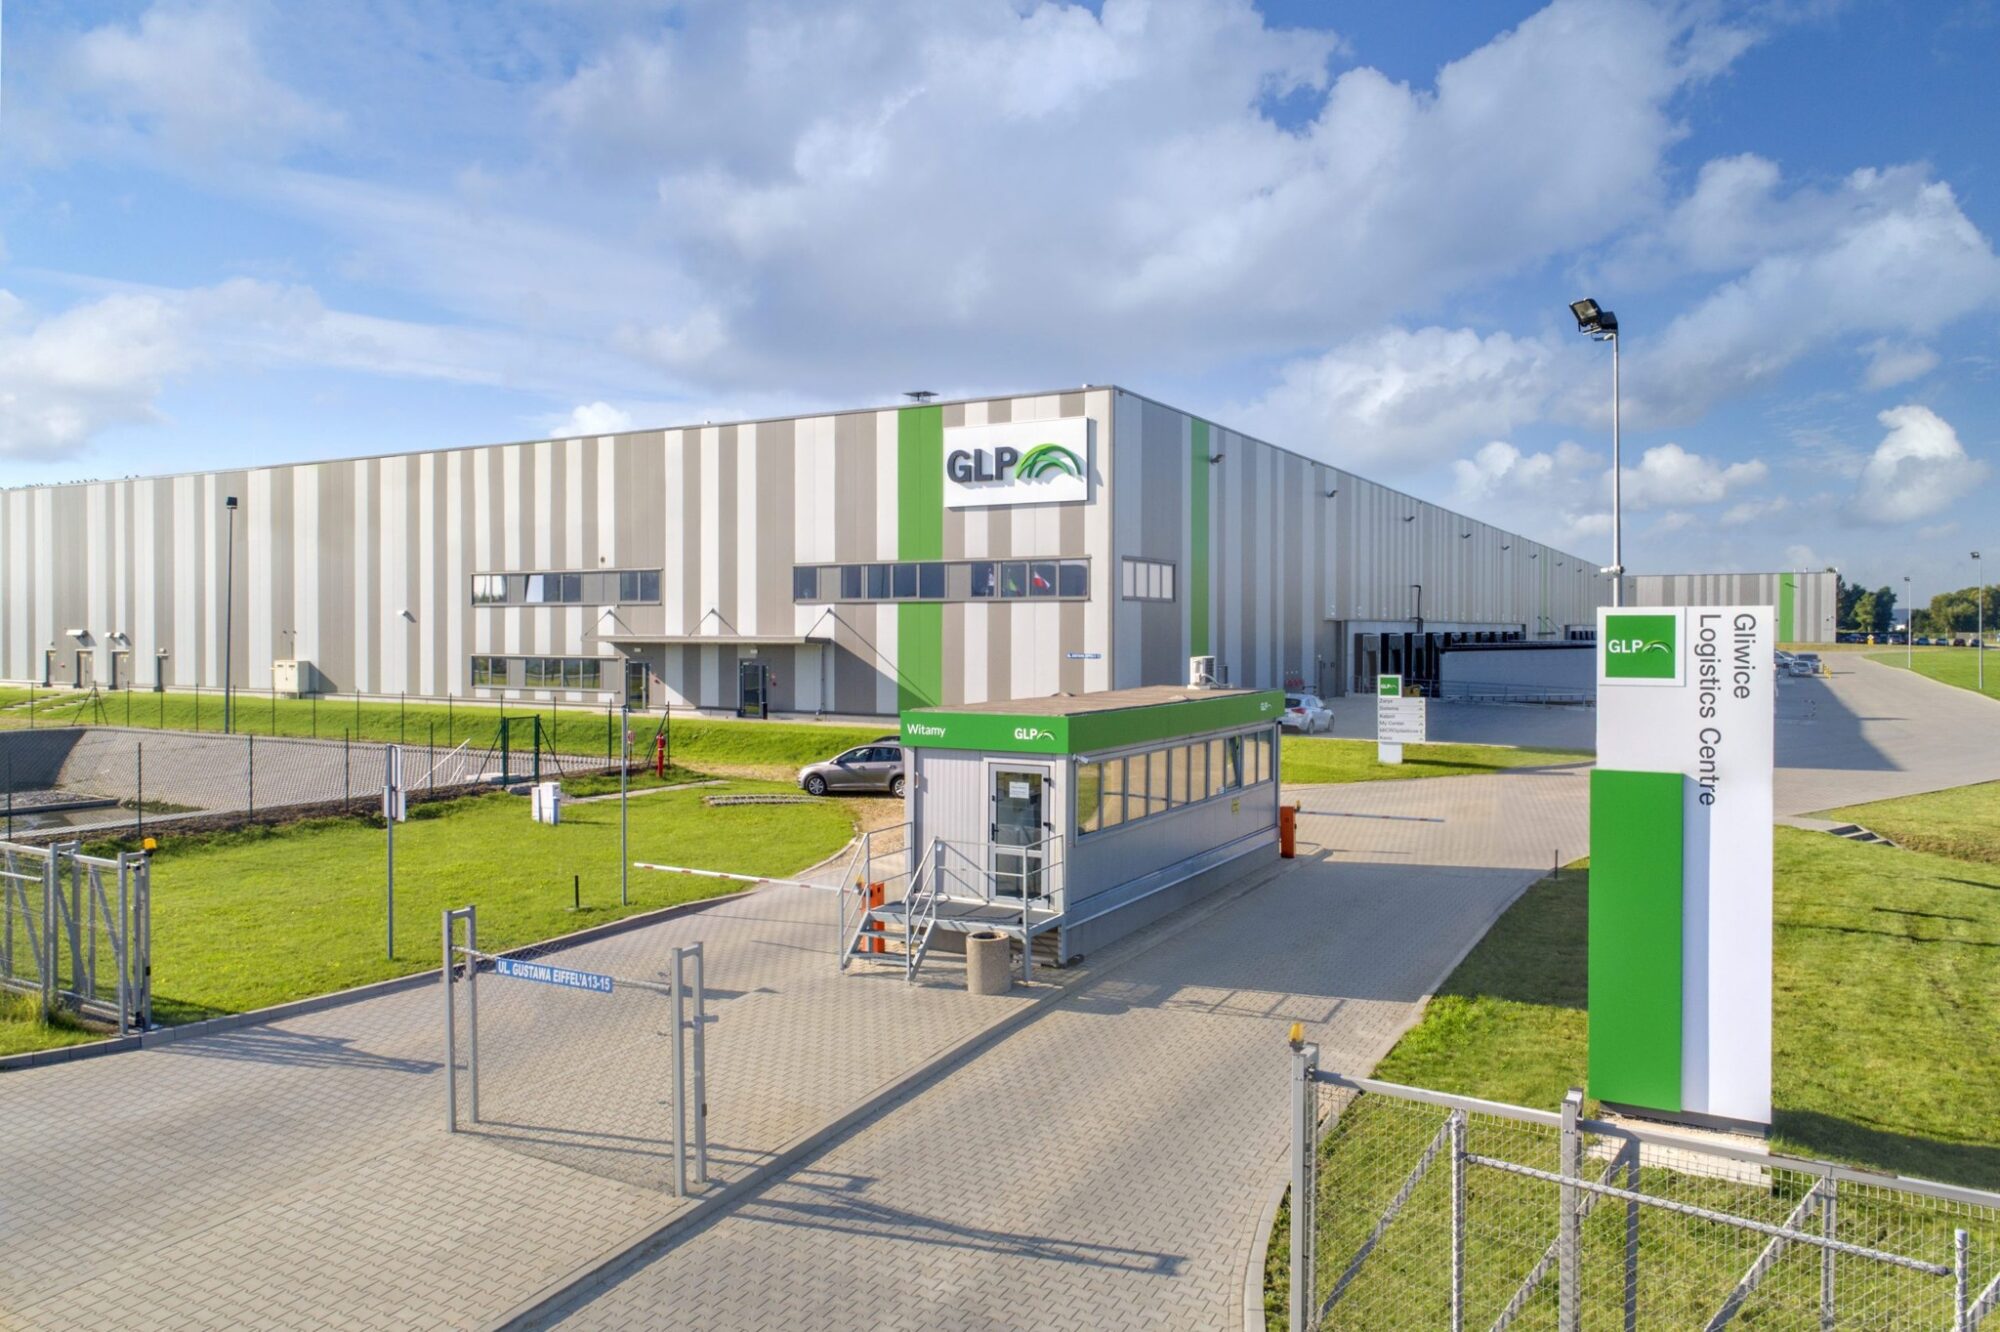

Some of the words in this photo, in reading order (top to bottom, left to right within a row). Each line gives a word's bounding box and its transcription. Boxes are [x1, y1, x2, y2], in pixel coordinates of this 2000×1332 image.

[947, 446, 1018, 483] GLP
[1608, 639, 1644, 654] GLP
[1733, 613, 1756, 699] Gliwice
[1694, 614, 1722, 718] Logistics
[907, 723, 946, 739] Witamy
[1014, 727, 1038, 740] GLP
[1699, 727, 1721, 806] Centre
[498, 960, 510, 974] UL.
[512, 962, 551, 982] GUSTAWA
